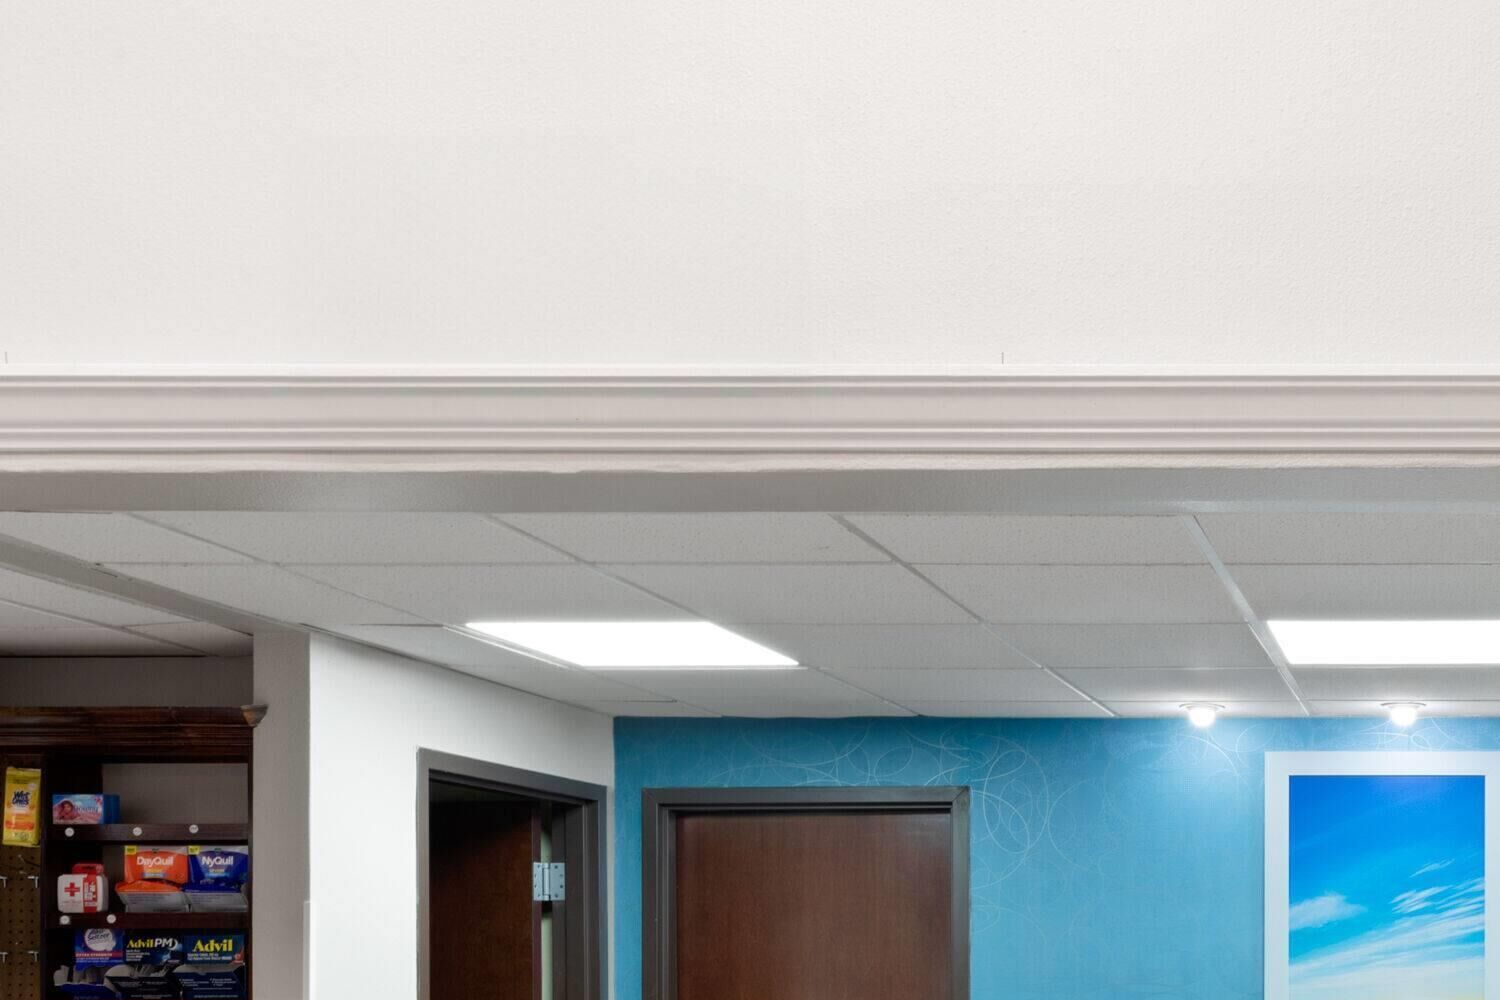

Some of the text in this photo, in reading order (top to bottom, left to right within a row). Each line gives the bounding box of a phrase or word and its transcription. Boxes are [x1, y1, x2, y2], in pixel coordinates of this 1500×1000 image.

[136, 856, 174, 868] DayQuil
[201, 856, 234, 868] NyQuil
[126, 937, 174, 948] Advil PM
[192, 938, 233, 952] Advil
